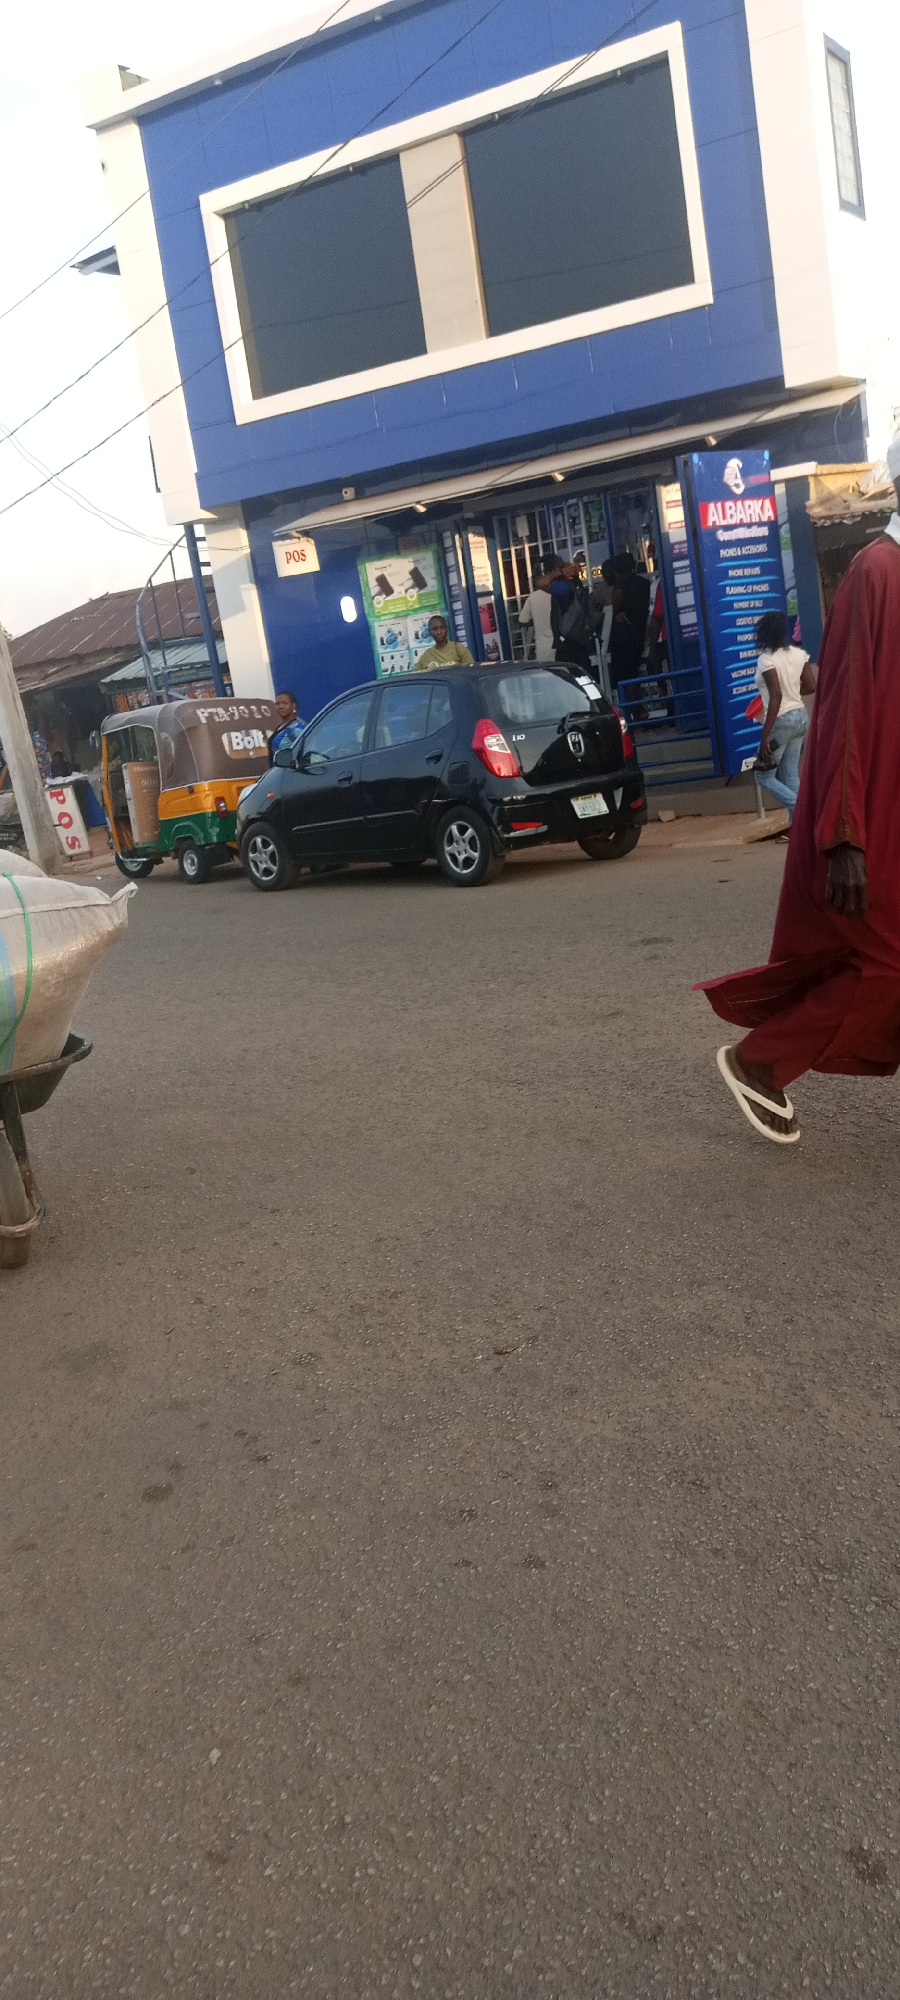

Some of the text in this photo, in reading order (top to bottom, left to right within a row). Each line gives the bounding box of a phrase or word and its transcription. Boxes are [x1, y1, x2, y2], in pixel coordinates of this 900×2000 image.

[707, 499, 774, 527] ALBARKA
[285, 549, 306, 564] POS
[230, 729, 266, 750] Bolt
[49, 788, 82, 850] POS
